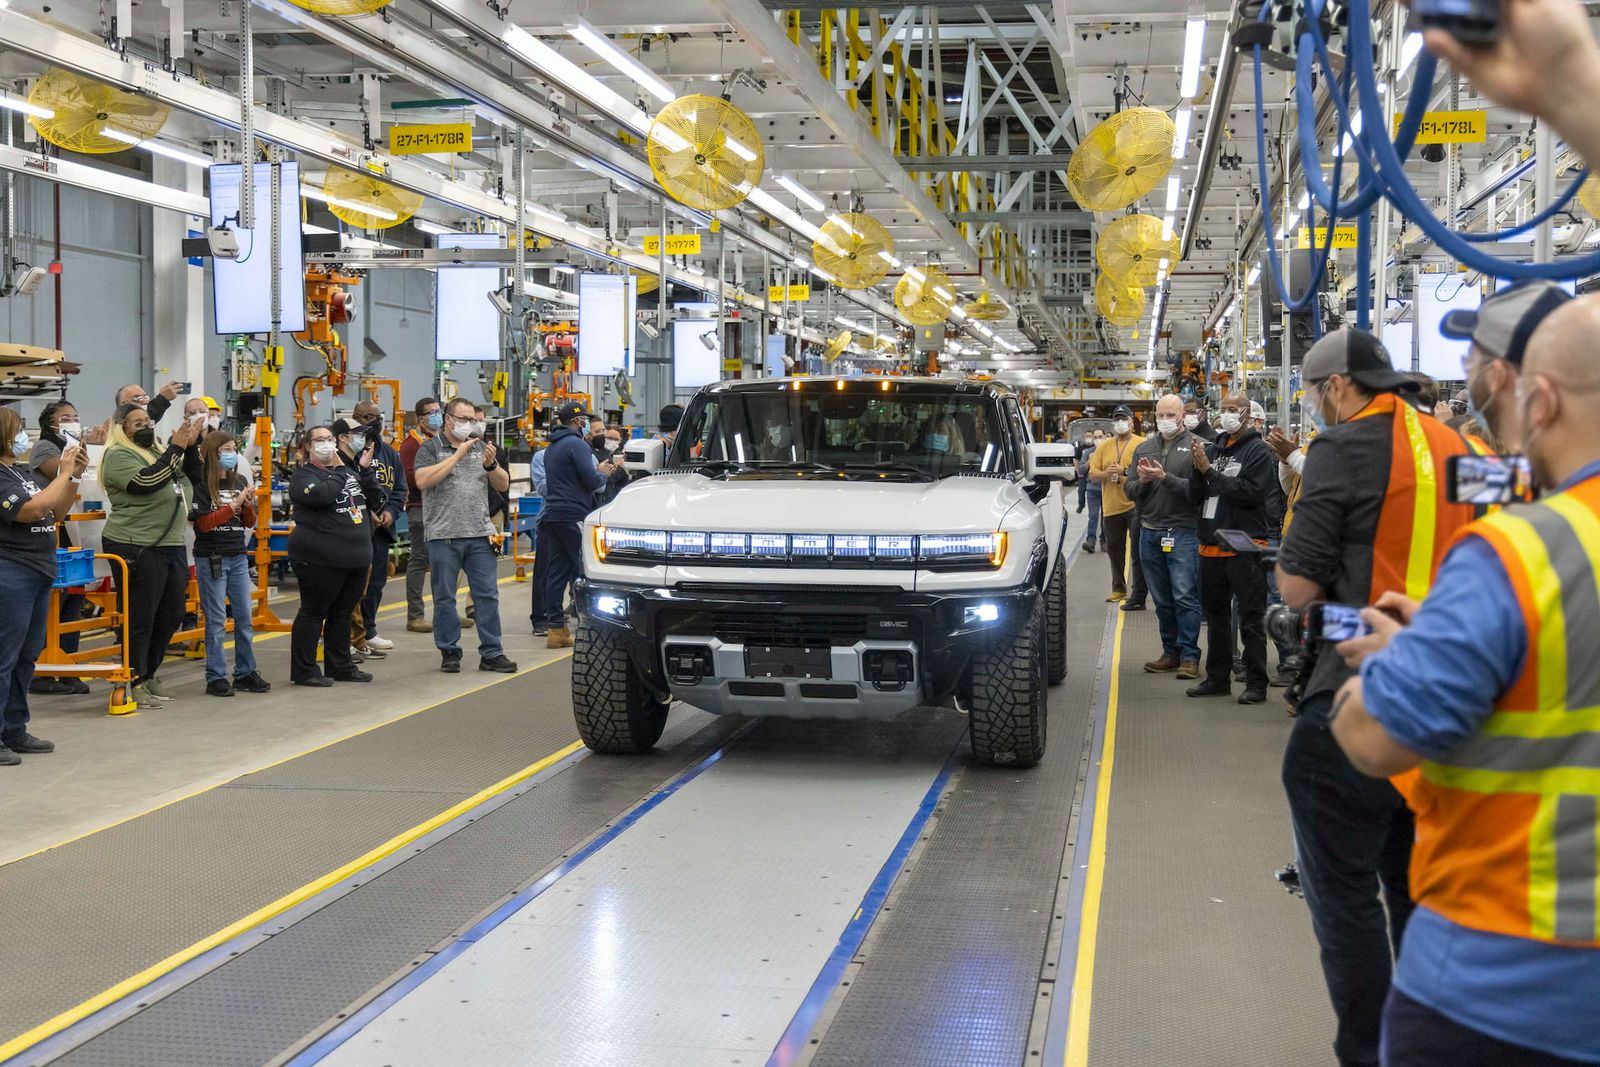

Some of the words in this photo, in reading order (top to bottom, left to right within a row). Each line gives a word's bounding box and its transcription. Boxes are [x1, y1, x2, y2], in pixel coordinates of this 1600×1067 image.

[1398, 121, 1476, 135] -F1-178L
[396, 132, 464, 147] 27-F1-178R
[1305, 233, 1355, 242] 27-F177L
[648, 240, 695, 250] 271-177R
[683, 537, 899, 548] HUMMER
[880, 620, 908, 628] GMC
